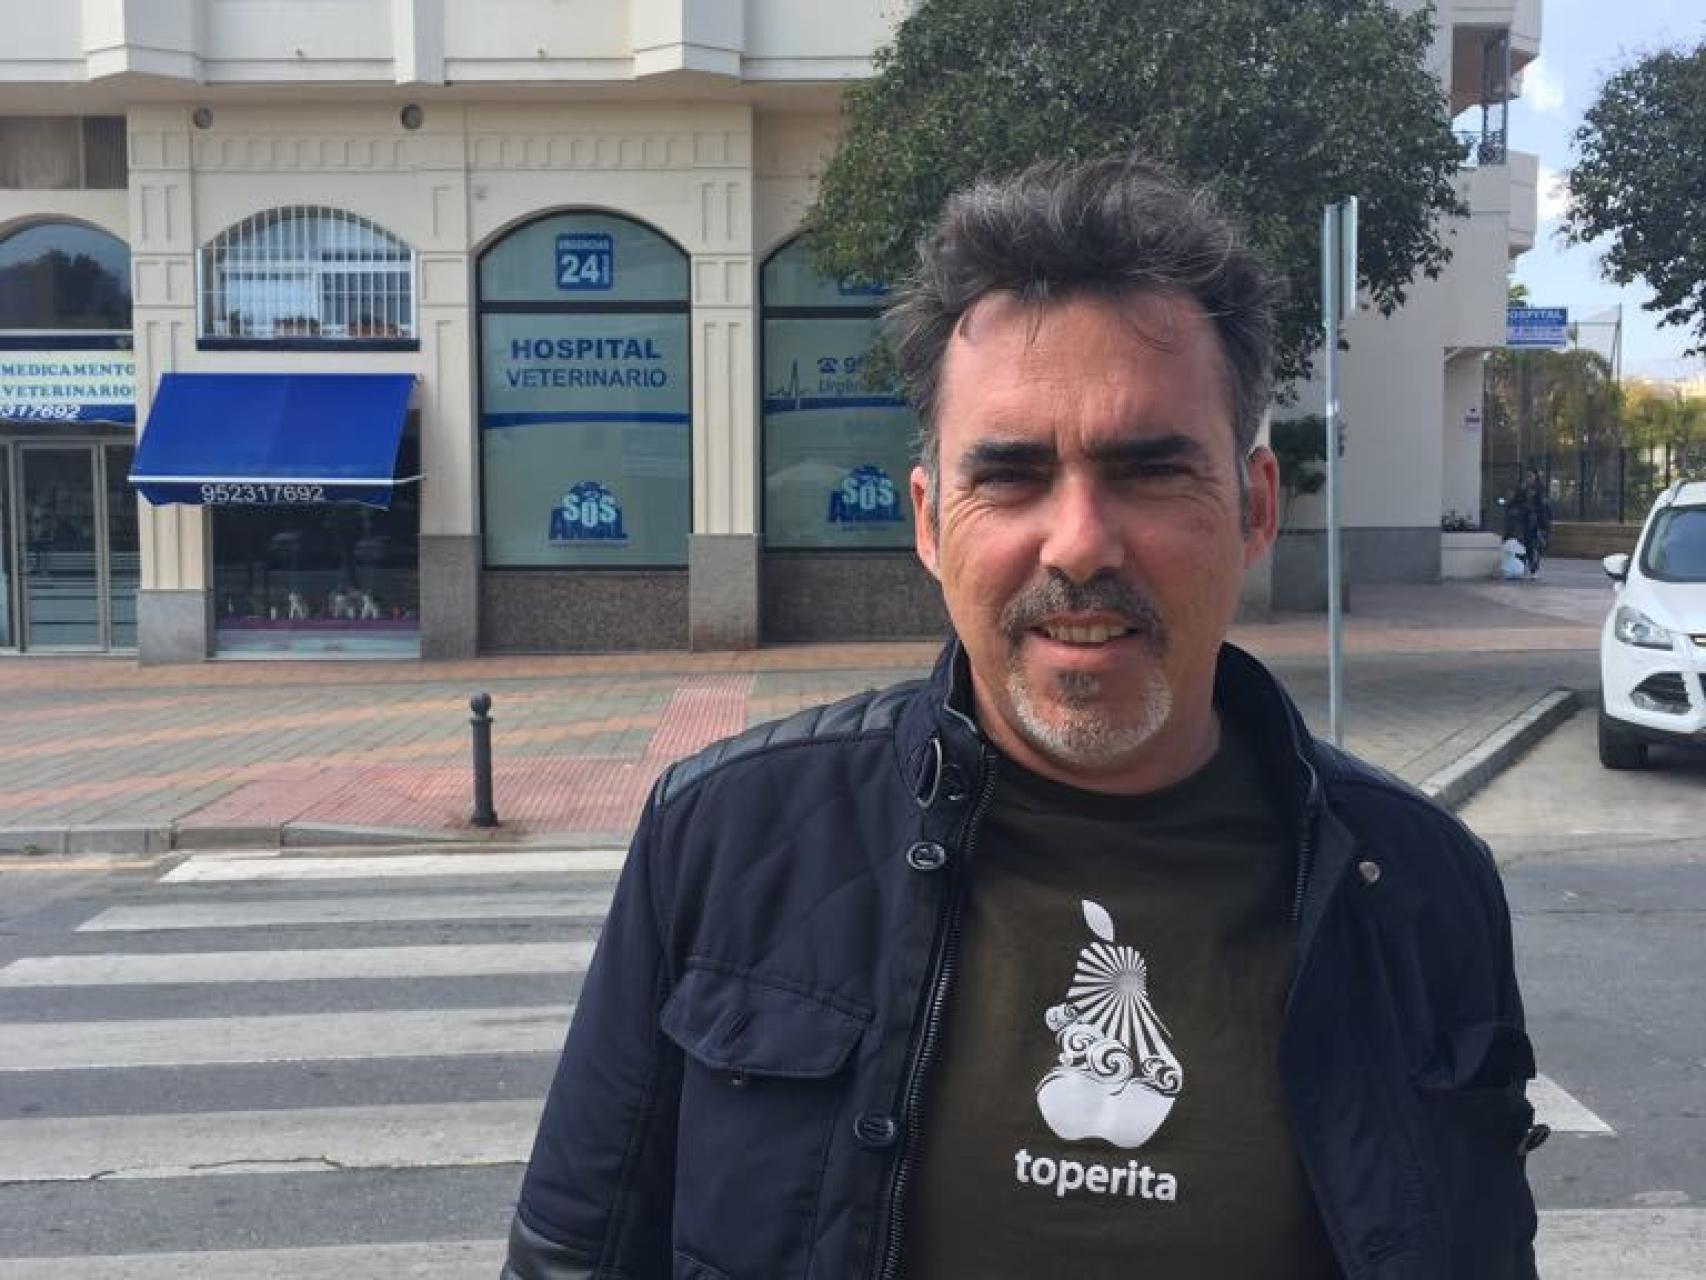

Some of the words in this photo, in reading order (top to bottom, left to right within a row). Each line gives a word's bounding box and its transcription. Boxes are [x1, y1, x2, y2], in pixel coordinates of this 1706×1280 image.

[561, 254, 600, 283] 24
[511, 339, 661, 360] HOSPITAL
[506, 368, 667, 388] VETERINARIO
[201, 483, 326, 503] 952317692
[843, 478, 894, 510] SOS
[562, 494, 616, 528] SOS
[1014, 1149, 1178, 1201] toperita
